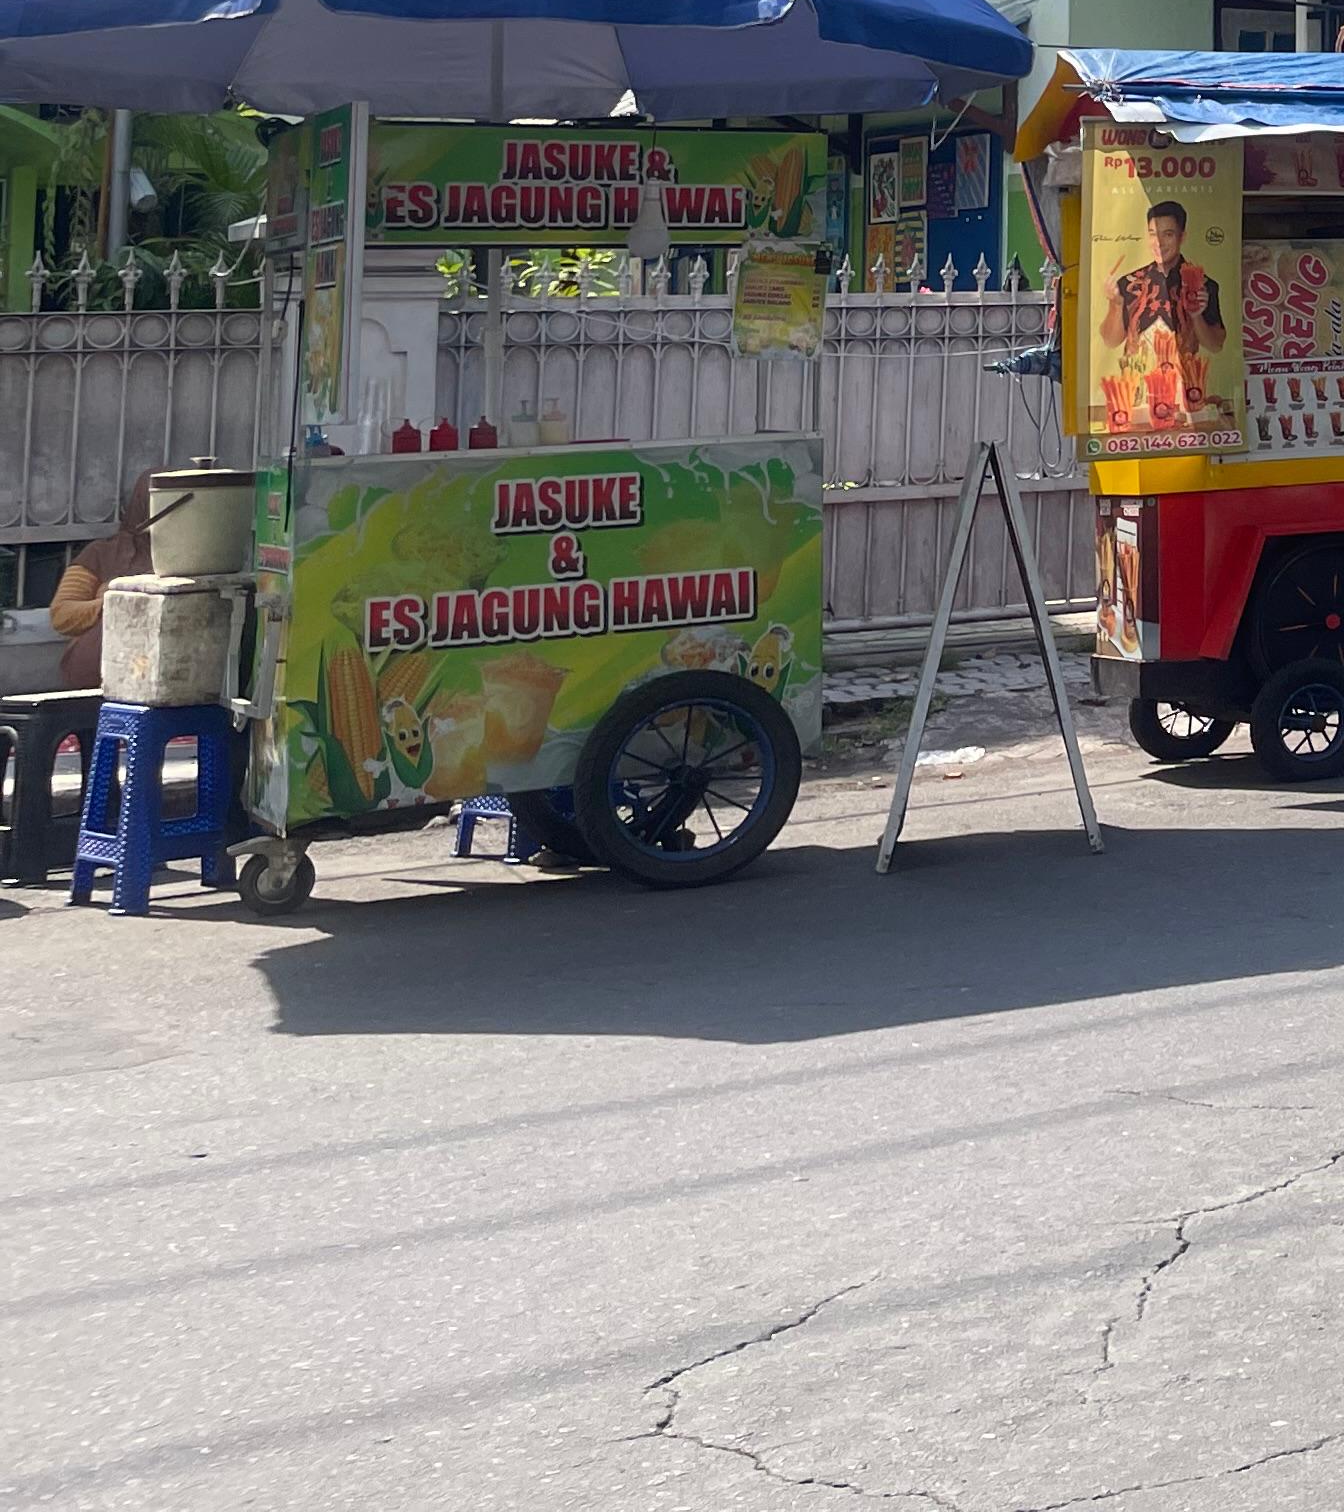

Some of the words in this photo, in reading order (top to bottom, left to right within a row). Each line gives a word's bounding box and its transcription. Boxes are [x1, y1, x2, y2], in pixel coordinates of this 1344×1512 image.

[1101, 129, 1147, 146] WONG
[502, 141, 638, 181] JASUKE
[645, 146, 672, 181] &
[385, 186, 434, 225] ES
[443, 186, 602, 225] JAGUNG
[613, 186, 743, 225] HWAI
[1107, 438, 1139, 453] 082
[1143, 437, 1173, 450] 144
[1178, 434, 1207, 448] 622
[1212, 431, 1241, 445] 022
[493, 475, 641, 530] JASUKE
[548, 533, 581, 575] &
[368, 596, 422, 648] ES
[431, 581, 602, 644] JAGUNG
[612, 568, 751, 627] HAWAI
